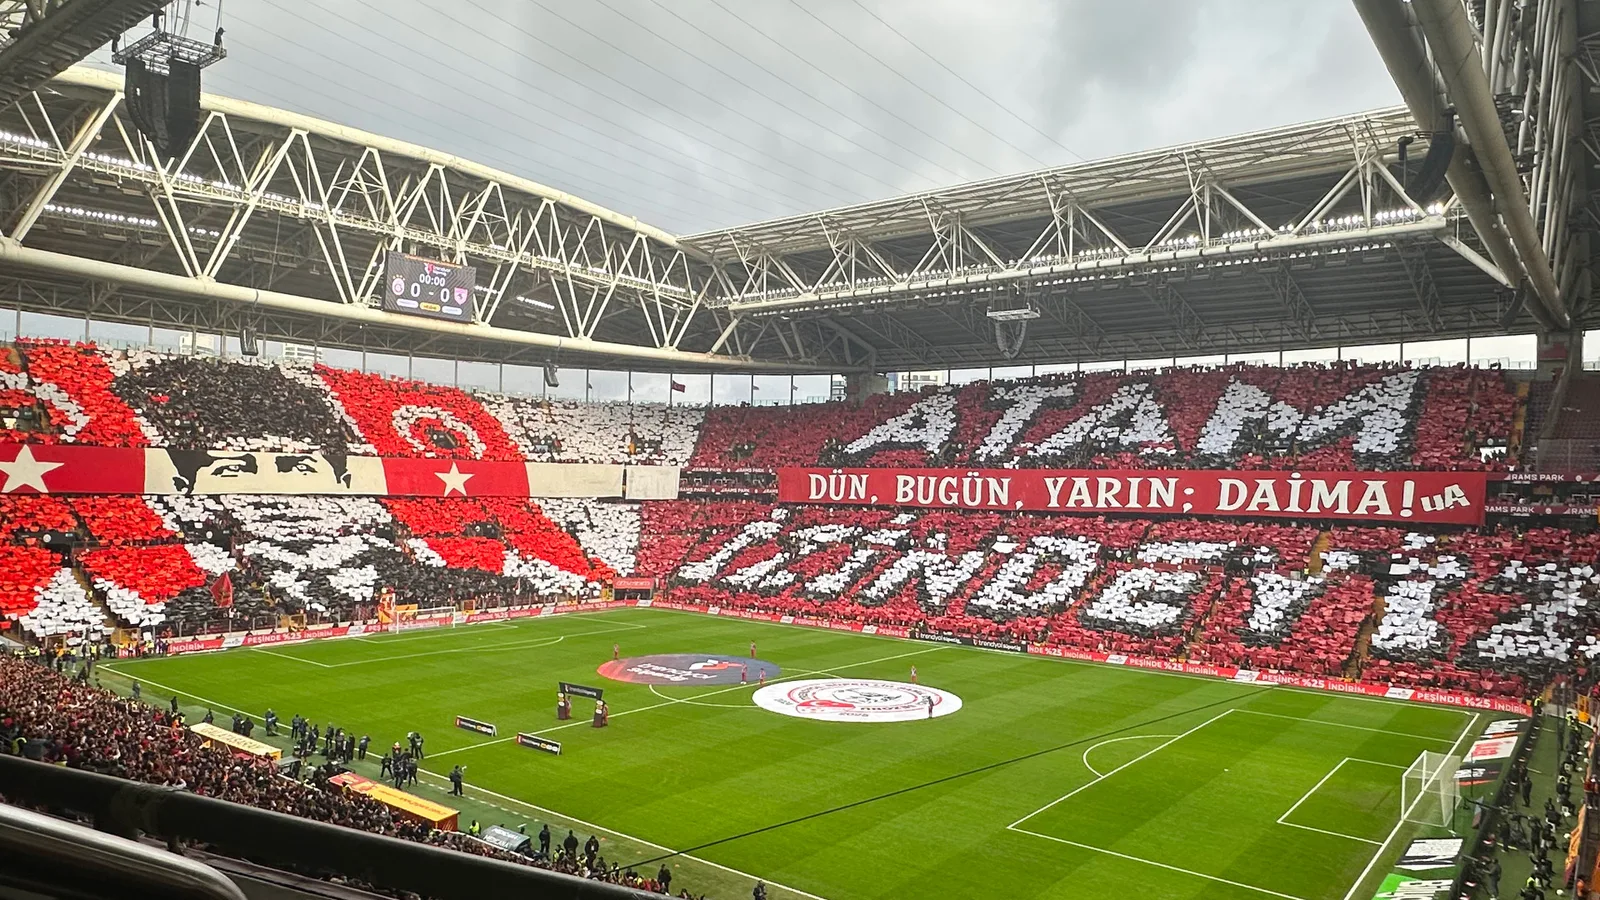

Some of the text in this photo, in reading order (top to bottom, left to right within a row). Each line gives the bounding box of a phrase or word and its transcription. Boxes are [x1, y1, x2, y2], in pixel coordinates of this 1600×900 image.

[420, 274, 445, 287] 00:00
[411, 283, 420, 297] 0
[440, 288, 450, 302] 0
[843, 370, 1421, 460] ATAM
[808, 469, 878, 504] DÜN,
[896, 472, 1023, 510] BUGÜN,
[1215, 472, 1415, 518] DAİMA!
[1571, 507, 1598, 515] RAMS
[247, 634, 280, 644] PEŞİNDE
[282, 632, 301, 641] %25
[303, 629, 333, 638] İNDİRİM
[170, 642, 204, 652] İNDİRİM
[1045, 647, 1062, 657] %25
[1064, 649, 1092, 660] İNDİRİM
[1130, 658, 1162, 668] PEŞİNDE
[1164, 661, 1183, 672] %25
[1186, 664, 1218, 676] İNDİRİM
[1262, 674, 1299, 685] PEŞİNDE
[1302, 678, 1325, 689] %25
[1328, 681, 1365, 693] İNDİRİM
[1417, 692, 1461, 704] PEŞİNDE
[1464, 696, 1490, 709] %25
